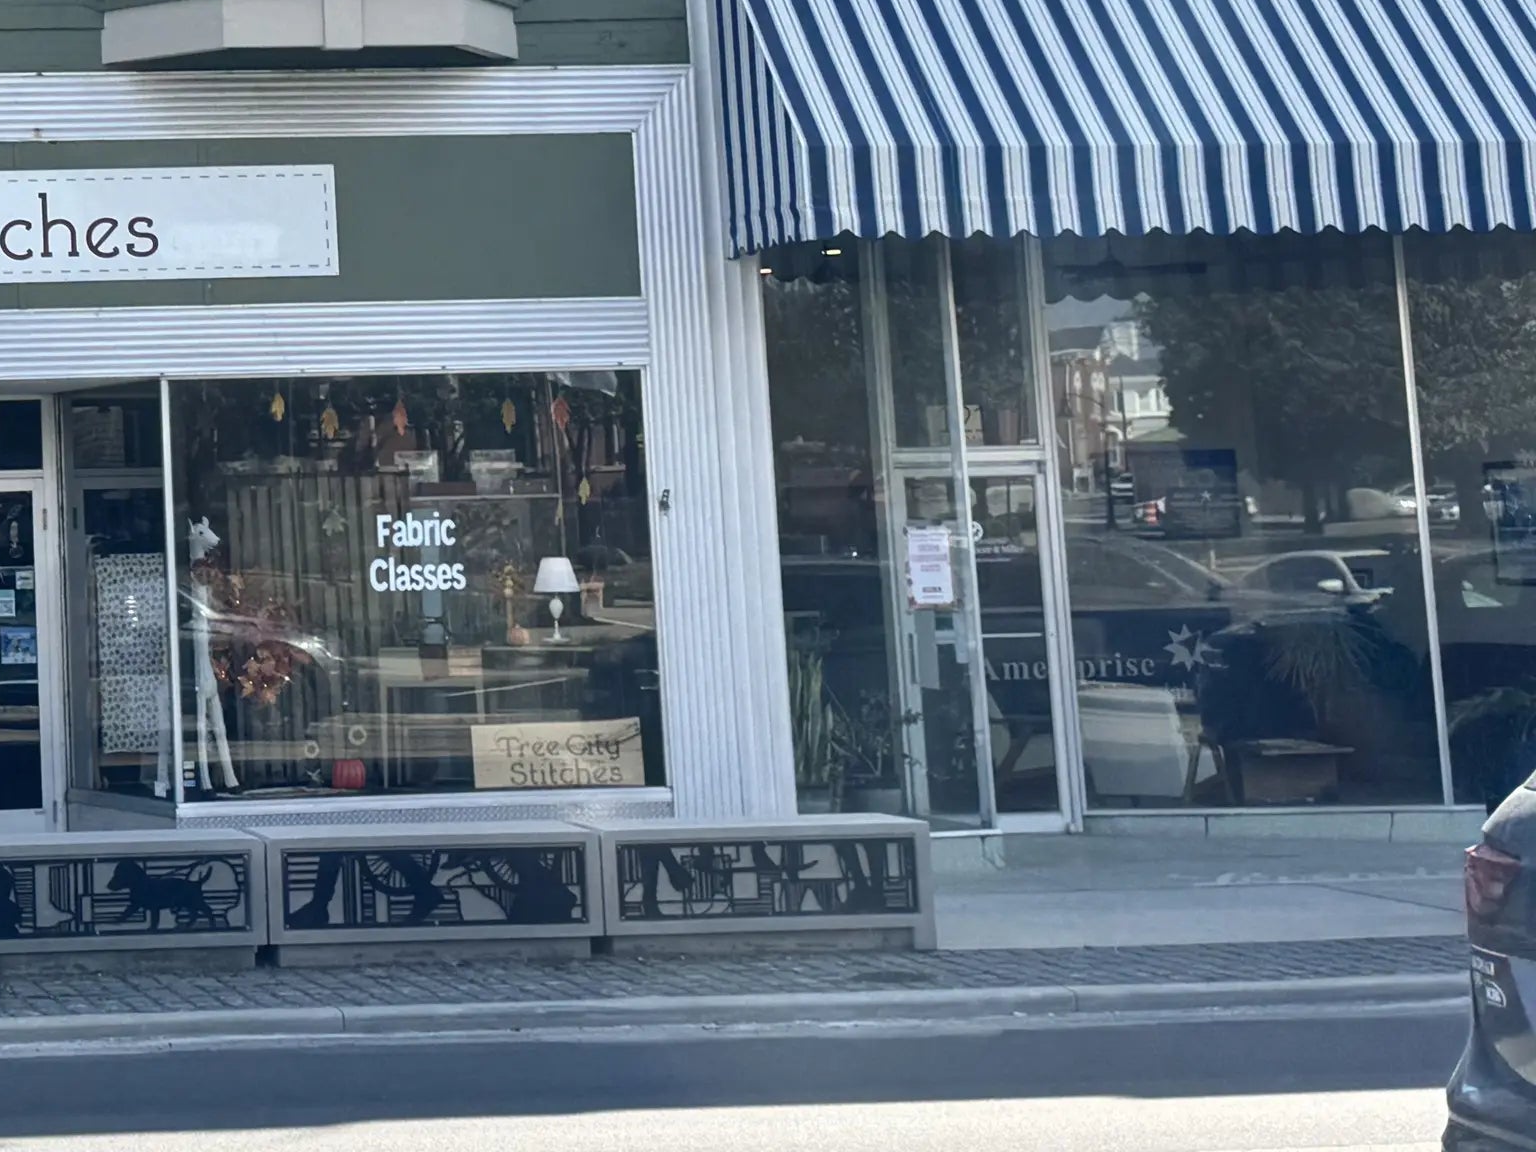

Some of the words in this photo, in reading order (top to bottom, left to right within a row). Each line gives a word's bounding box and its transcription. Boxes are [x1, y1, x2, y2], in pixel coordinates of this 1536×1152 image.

[376, 511, 456, 548] Fabric
[369, 556, 467, 592] Classes
[495, 736, 560, 758] Tree
[565, 733, 622, 760] City
[510, 758, 624, 786] Stitches
